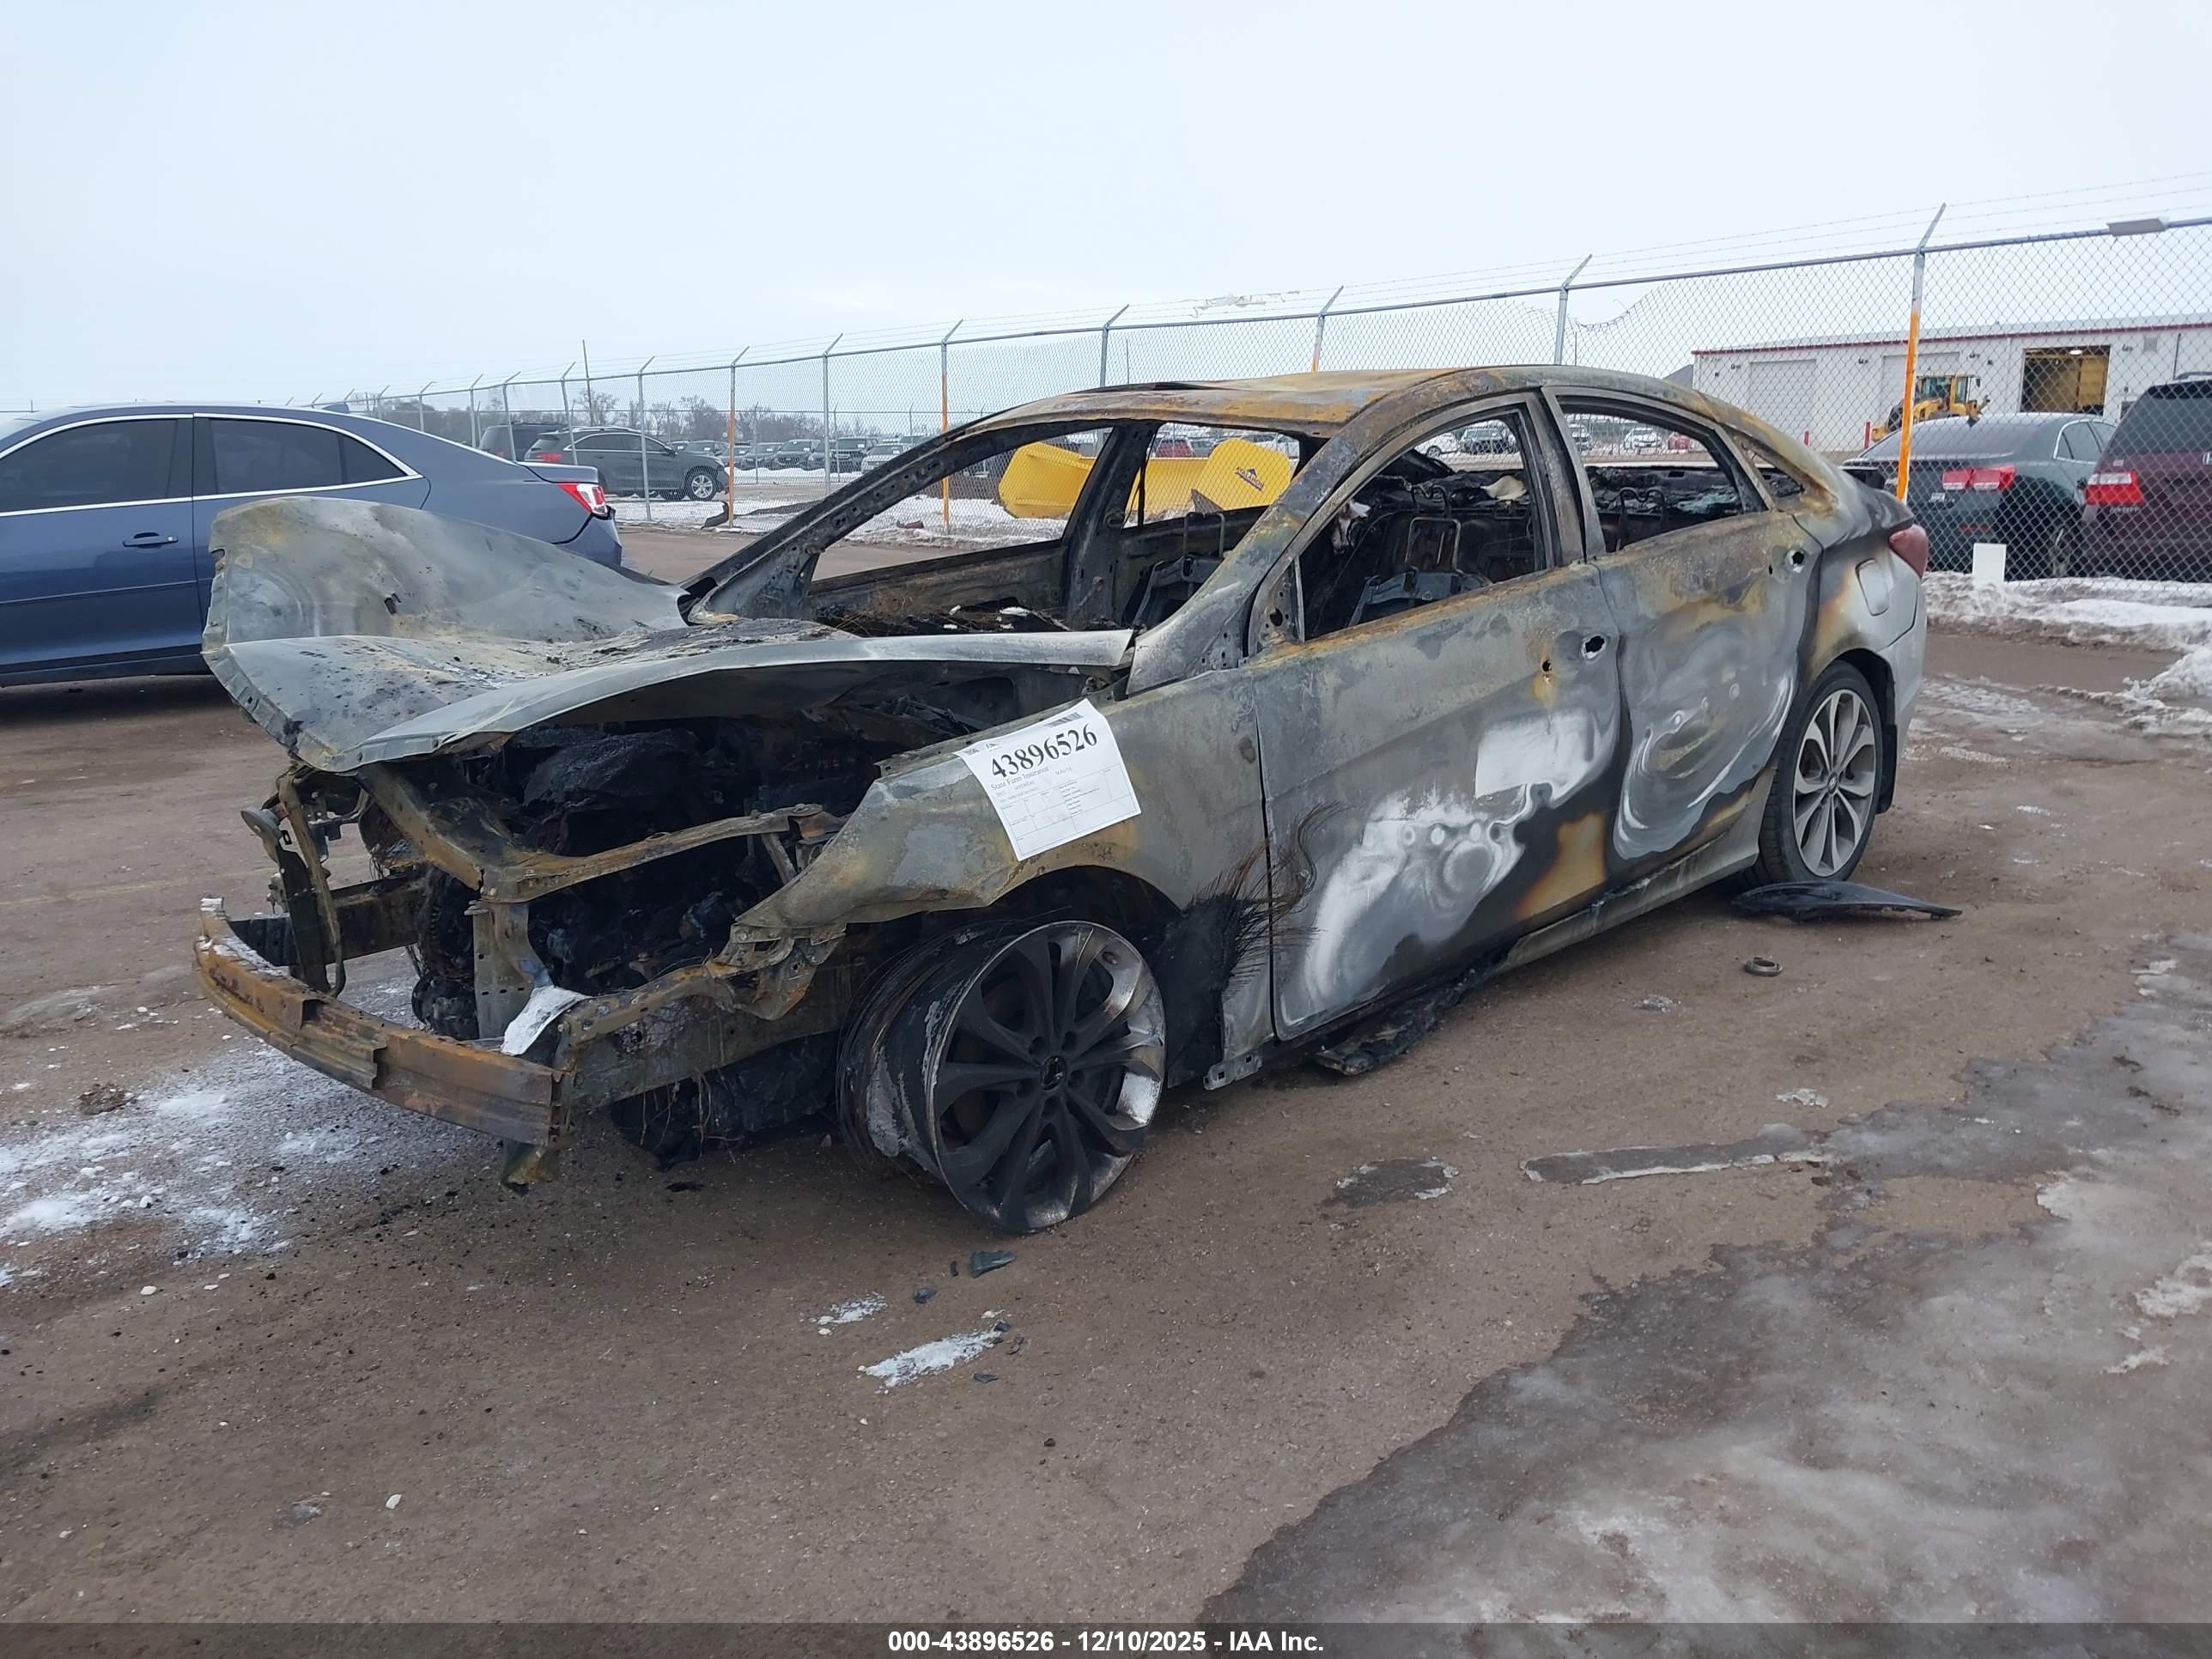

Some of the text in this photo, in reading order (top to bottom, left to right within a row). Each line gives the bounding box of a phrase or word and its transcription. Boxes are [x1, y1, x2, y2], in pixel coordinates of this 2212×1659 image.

[991, 723, 1097, 778] 43896526
[991, 781, 1007, 791] State
[1006, 775, 1022, 786] Farm
